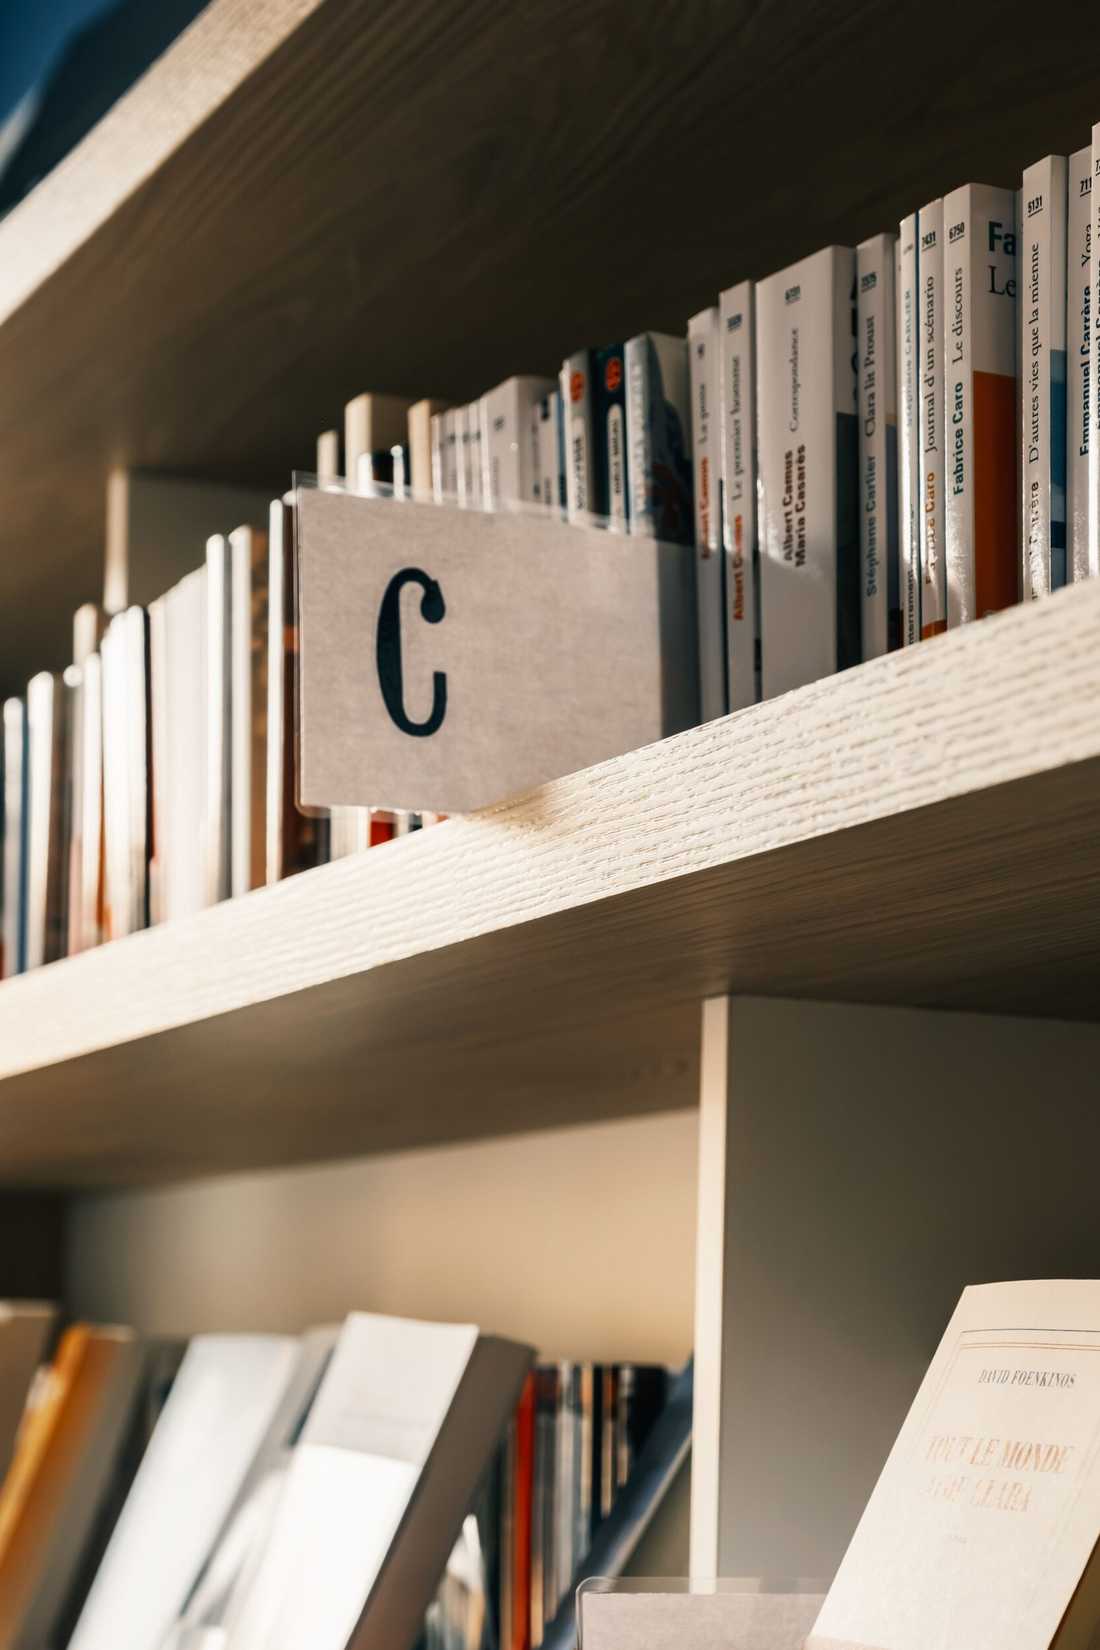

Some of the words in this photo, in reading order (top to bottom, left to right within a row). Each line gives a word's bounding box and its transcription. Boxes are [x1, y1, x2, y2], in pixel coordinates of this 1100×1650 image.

[1027, 195, 1042, 213] 5131
[949, 222, 965, 240] 6750
[989, 220, 1016, 256] Fa
[988, 265, 1016, 297] Le
[1029, 241, 1039, 304] mienne
[925, 276, 935, 342] scénario
[952, 267, 963, 336] discours
[1028, 308, 1039, 324] la
[952, 342, 963, 365] Le
[1031, 328, 1042, 357] que
[1028, 361, 1039, 393] vies
[864, 392, 876, 438] Clara
[925, 391, 937, 453] Journal
[952, 382, 963, 424] Caro
[1028, 396, 1039, 464] D'autres
[782, 450, 793, 508] Camus
[795, 444, 806, 513] Casarès
[866, 456, 876, 513] Carlier
[953, 428, 963, 495] Fabrice
[925, 472, 935, 513] Caro
[783, 511, 793, 561] Albert
[795, 517, 806, 567] Maria
[866, 516, 878, 597] Stéphane
[376, 567, 447, 737] C
[978, 1369, 1010, 1385] DAVID
[1011, 1370, 1077, 1388] FOENKINOS
